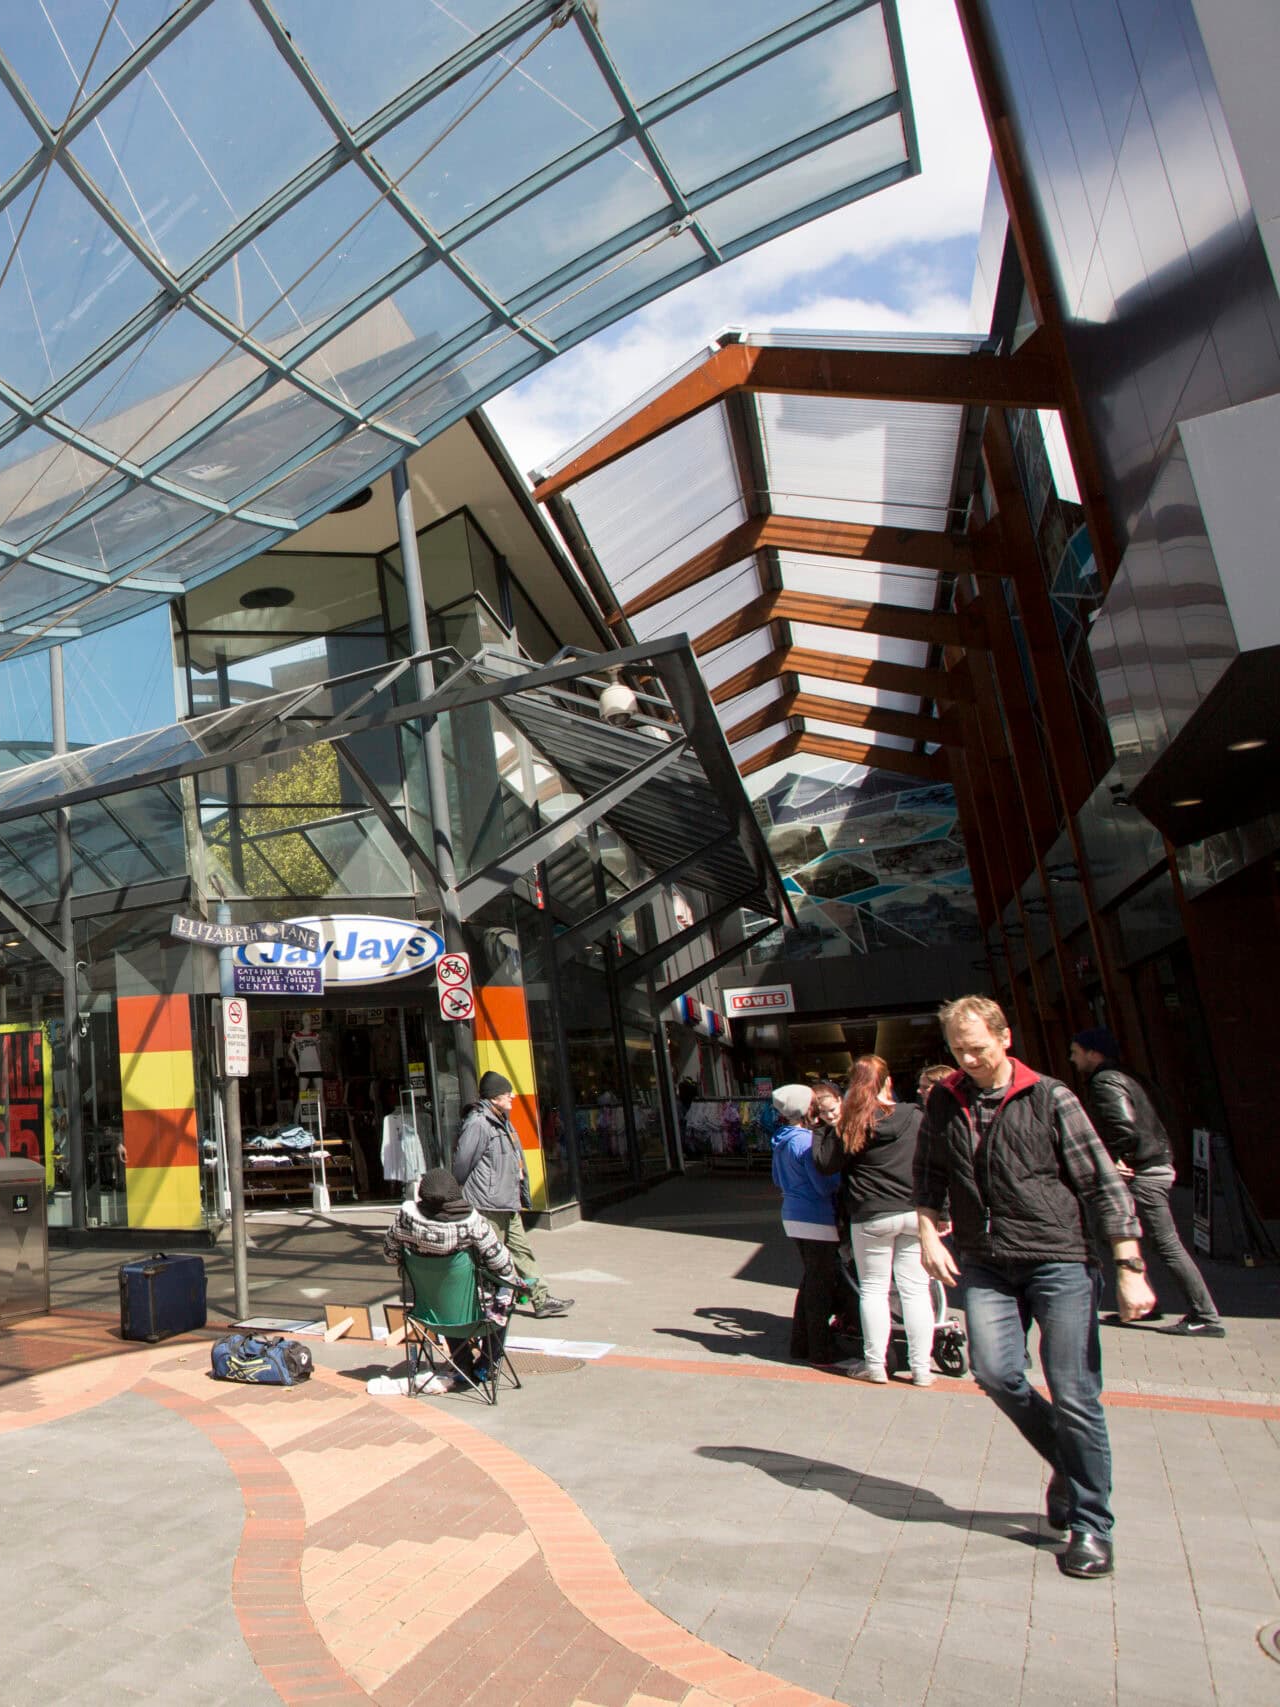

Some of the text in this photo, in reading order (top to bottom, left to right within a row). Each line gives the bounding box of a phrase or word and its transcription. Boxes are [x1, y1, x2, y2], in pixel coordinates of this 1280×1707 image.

[178, 919, 316, 948] ELIZABETH LANE
[239, 975, 272, 983] MURRAY
[284, 976, 317, 984] TOILETS
[238, 983, 315, 992] CENTREPOINT
[734, 994, 783, 1008] LOWES
